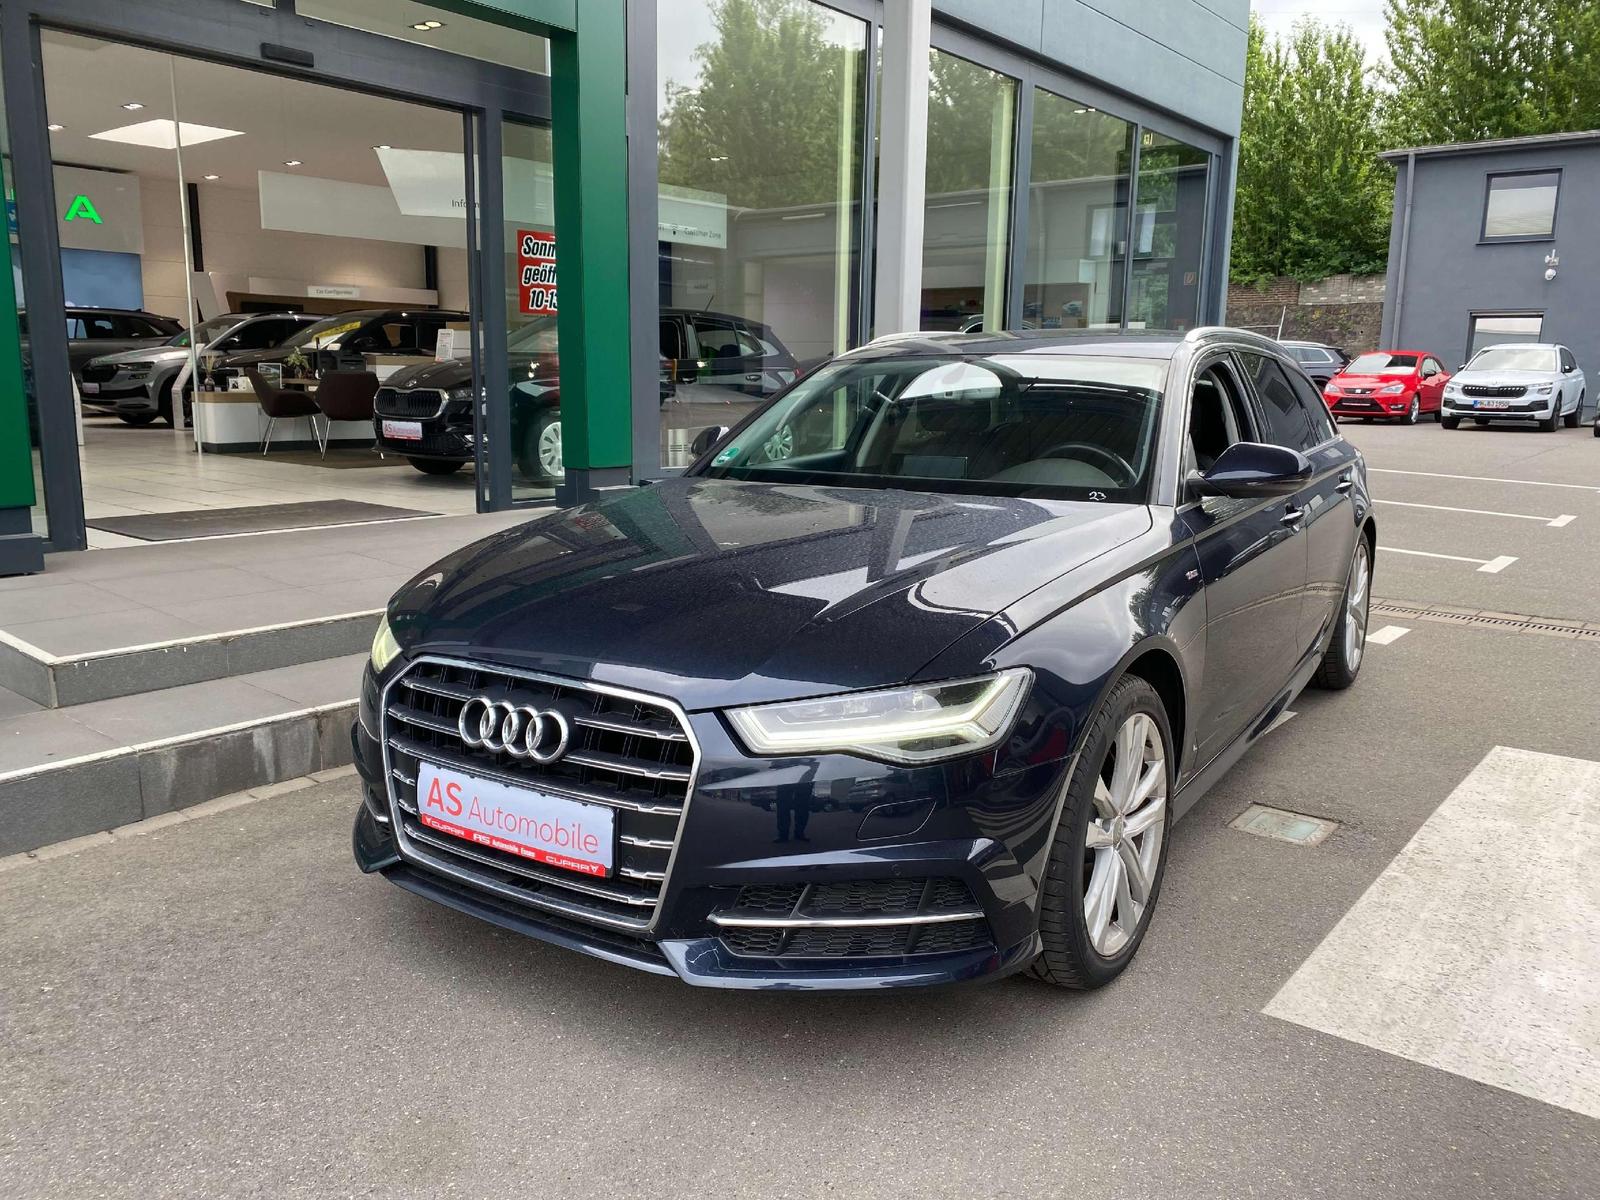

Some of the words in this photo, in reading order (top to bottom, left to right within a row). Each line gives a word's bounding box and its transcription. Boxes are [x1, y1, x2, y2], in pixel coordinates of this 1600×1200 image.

[426, 777, 463, 818] AS
[468, 796, 599, 854] Automobile
[472, 833, 491, 845] AS
[545, 855, 590, 871] CUPRA
